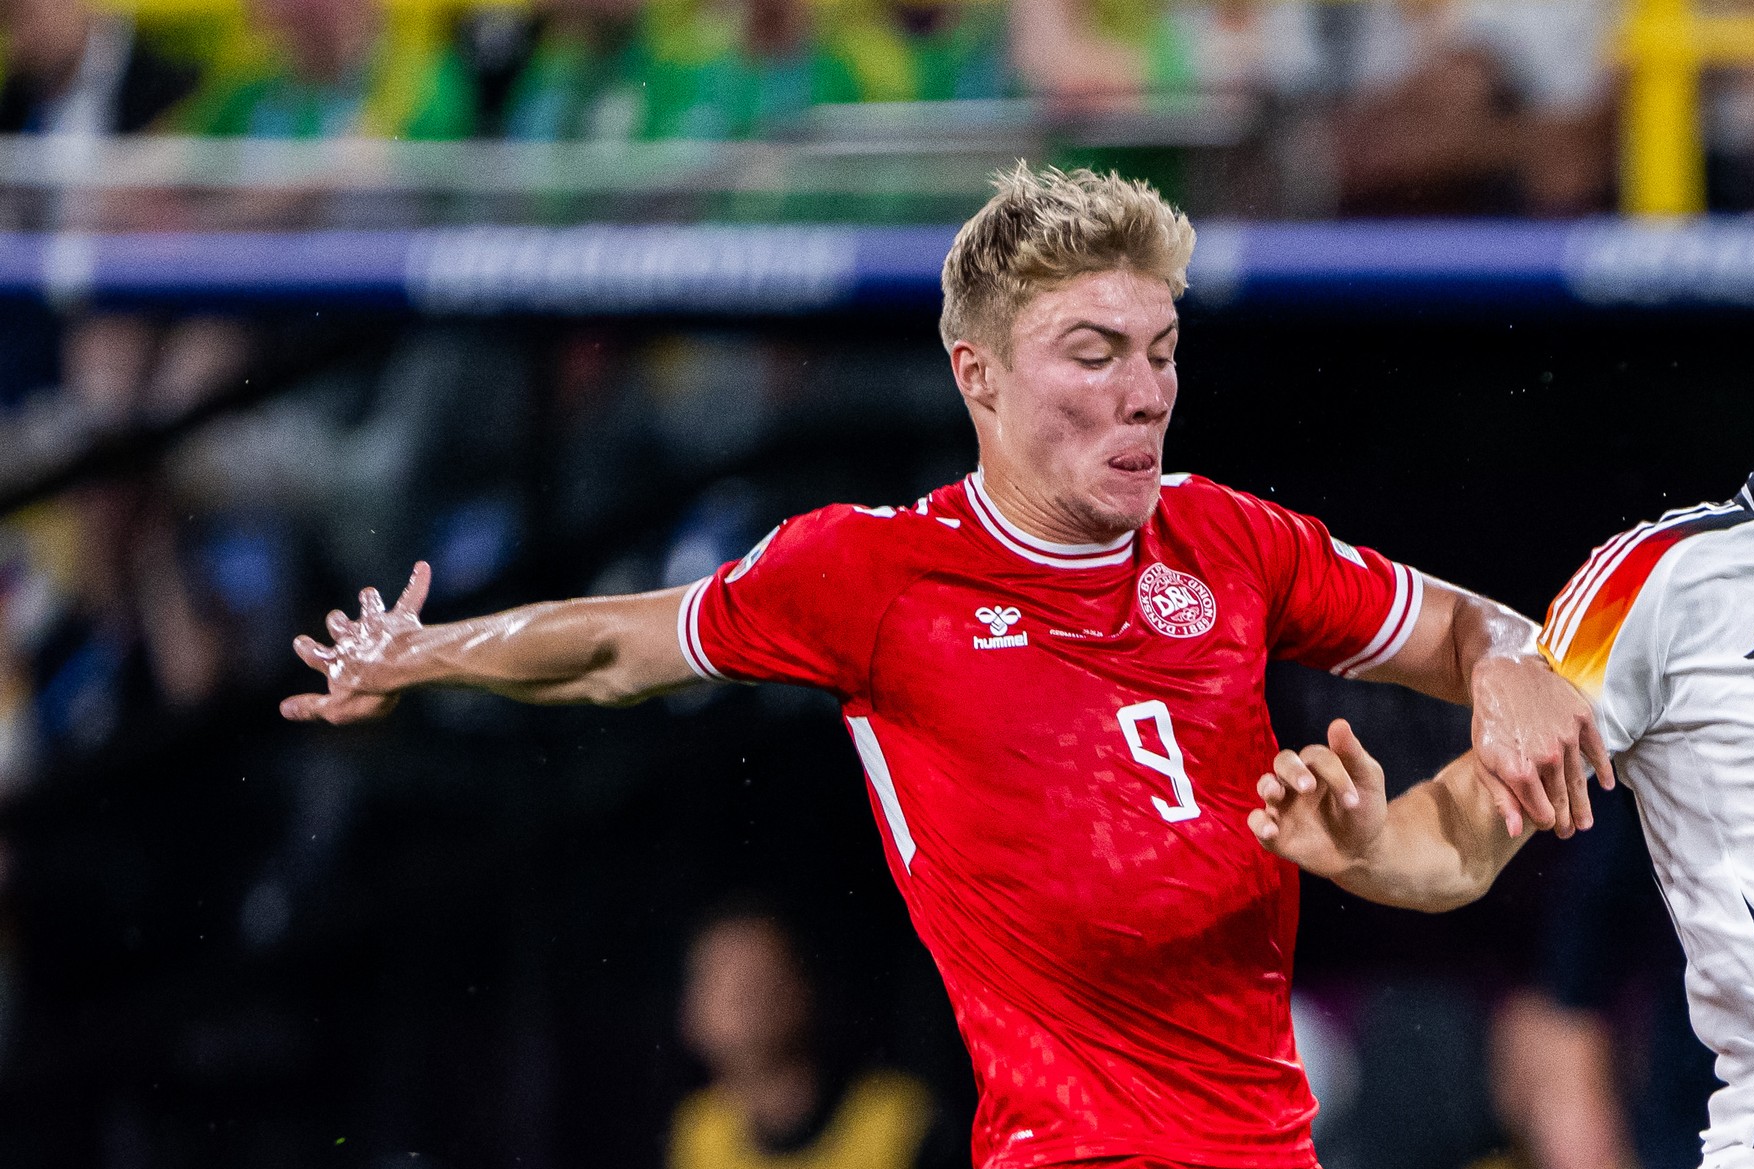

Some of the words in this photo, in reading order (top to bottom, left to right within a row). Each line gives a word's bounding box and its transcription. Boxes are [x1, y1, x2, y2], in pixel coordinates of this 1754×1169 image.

[1141, 595, 1176, 635] DANSK
[973, 630, 1029, 650] hummel
[1116, 699, 1202, 823] 9
